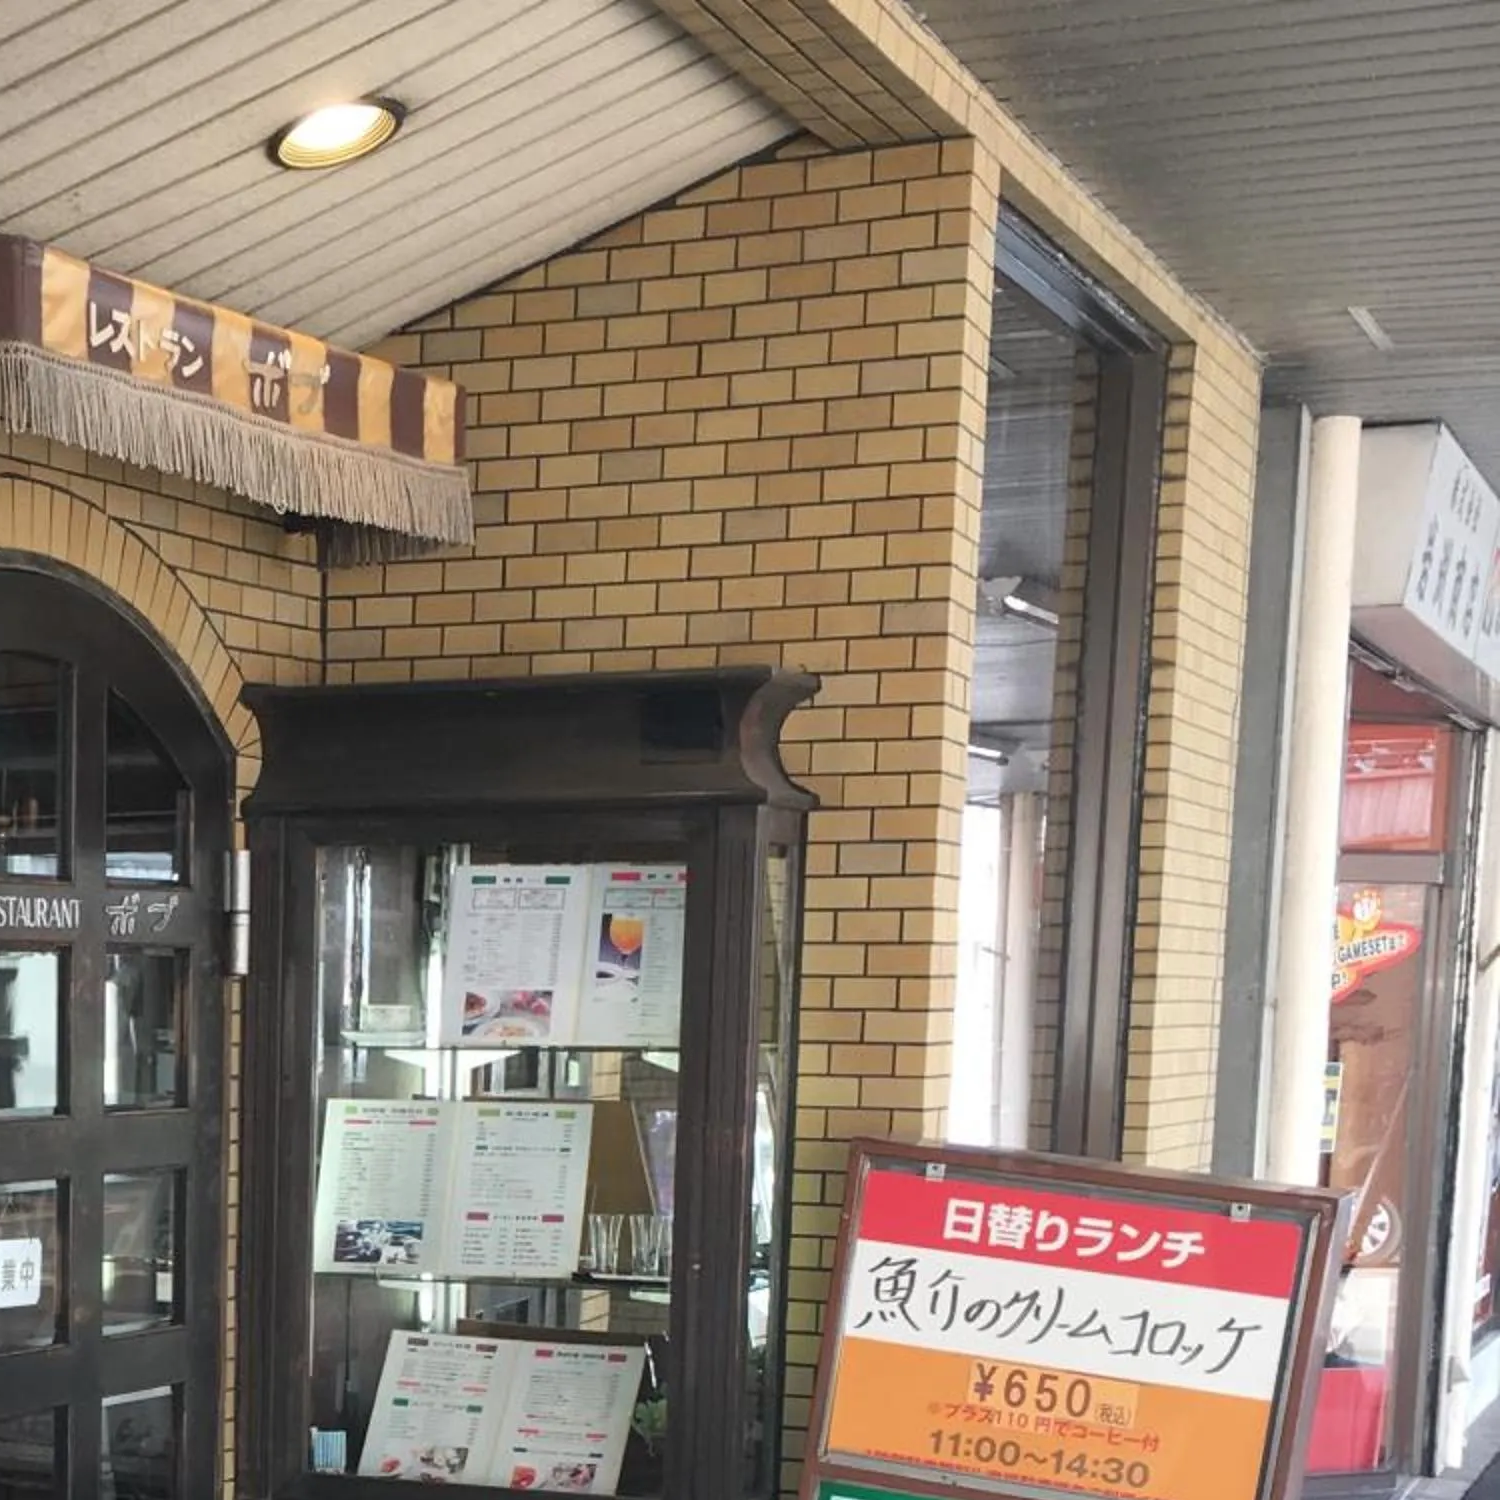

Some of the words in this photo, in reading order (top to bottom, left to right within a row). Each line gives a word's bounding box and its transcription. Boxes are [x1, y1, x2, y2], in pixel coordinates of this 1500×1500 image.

[89, 300, 204, 378] レストラン
[243, 348, 331, 414] ボブ
[105, 892, 180, 935] ボブ
[942, 1197, 1206, 1270] 日替りランチ
[853, 1255, 1263, 1374] 魚介のクリームコロッケ
[973, 1362, 1092, 1418] ¥650
